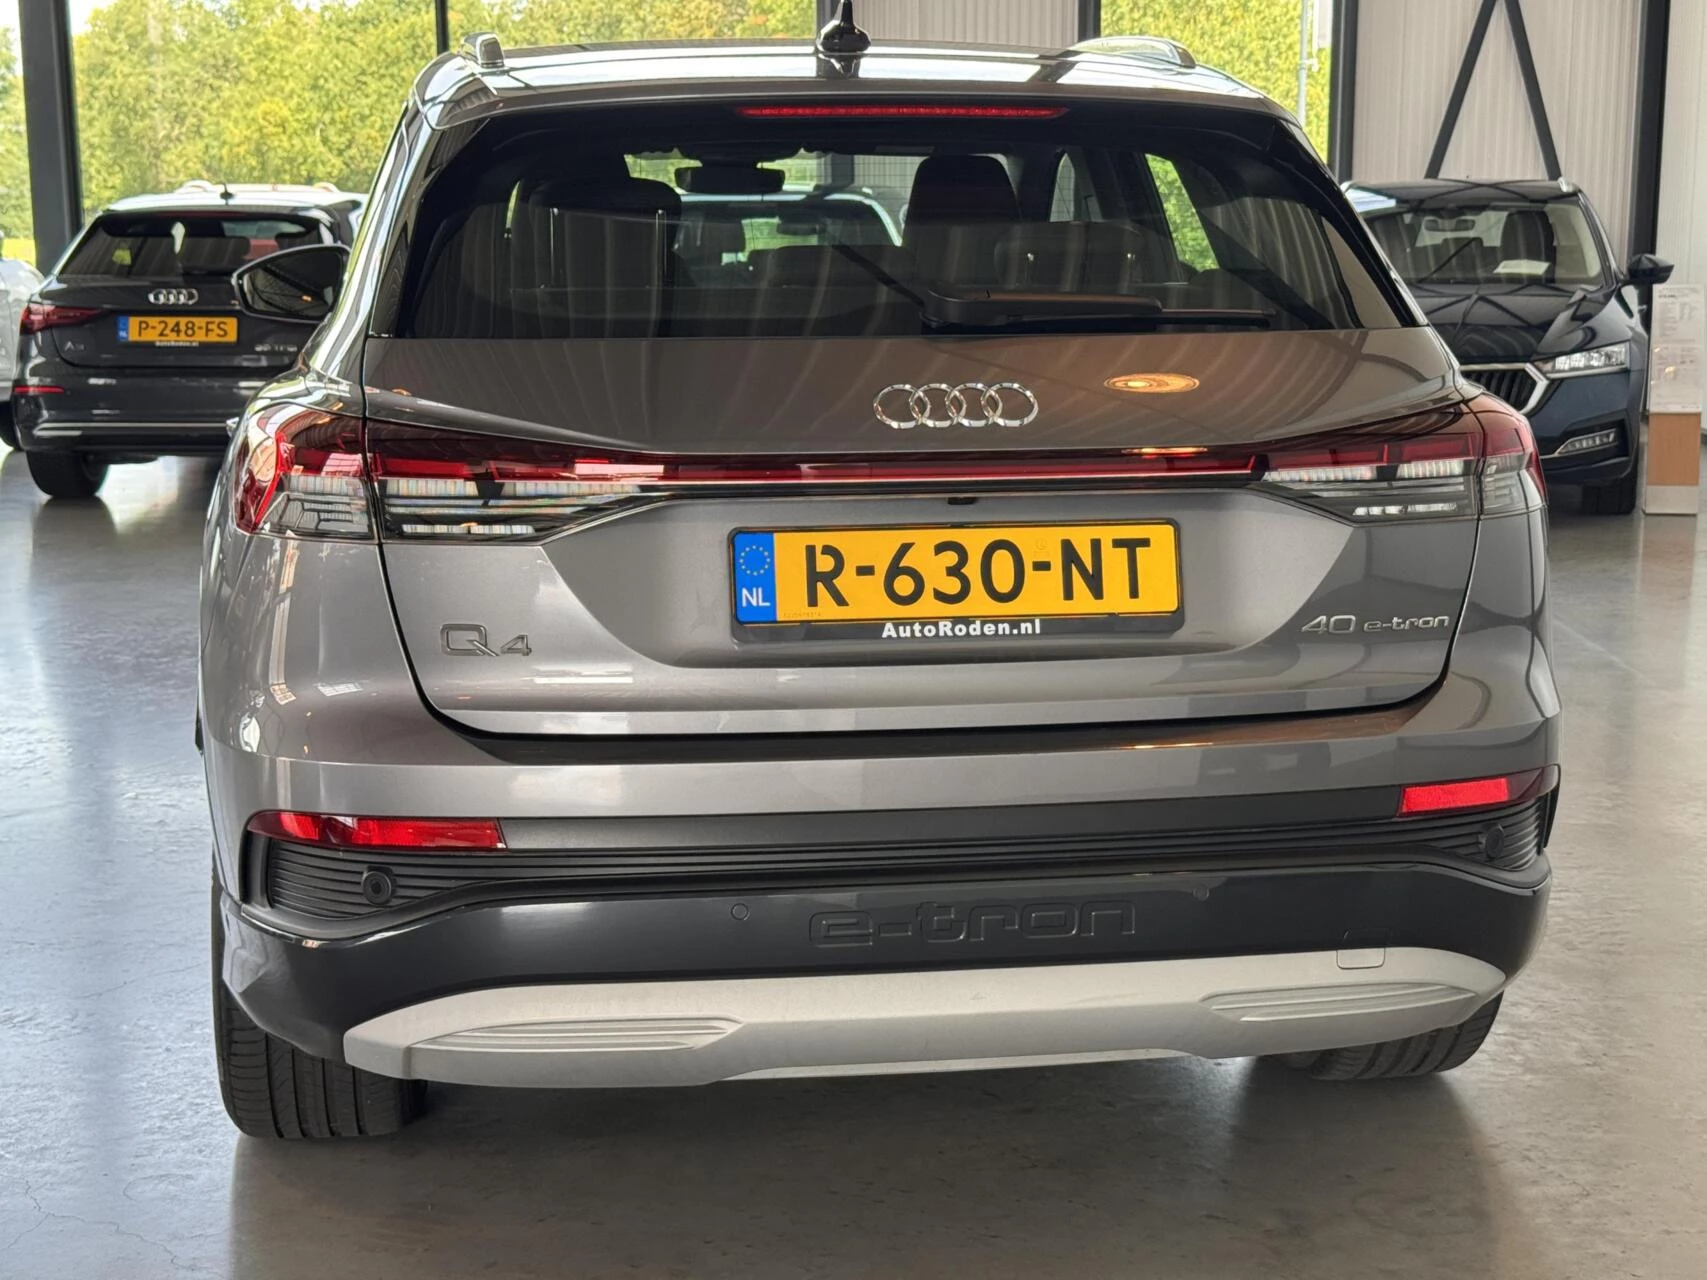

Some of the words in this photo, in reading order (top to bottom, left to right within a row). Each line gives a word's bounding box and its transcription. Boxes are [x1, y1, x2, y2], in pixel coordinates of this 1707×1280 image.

[138, 320, 228, 338] P-248-FS
[741, 586, 771, 608] NL
[804, 537, 1150, 608] R-630-NT
[881, 618, 1041, 639] AutoRoden.nl
[1301, 614, 1356, 634] 40
[1363, 615, 1450, 632] e-tron
[440, 623, 532, 657] Q4
[808, 900, 1136, 949] e-tron
